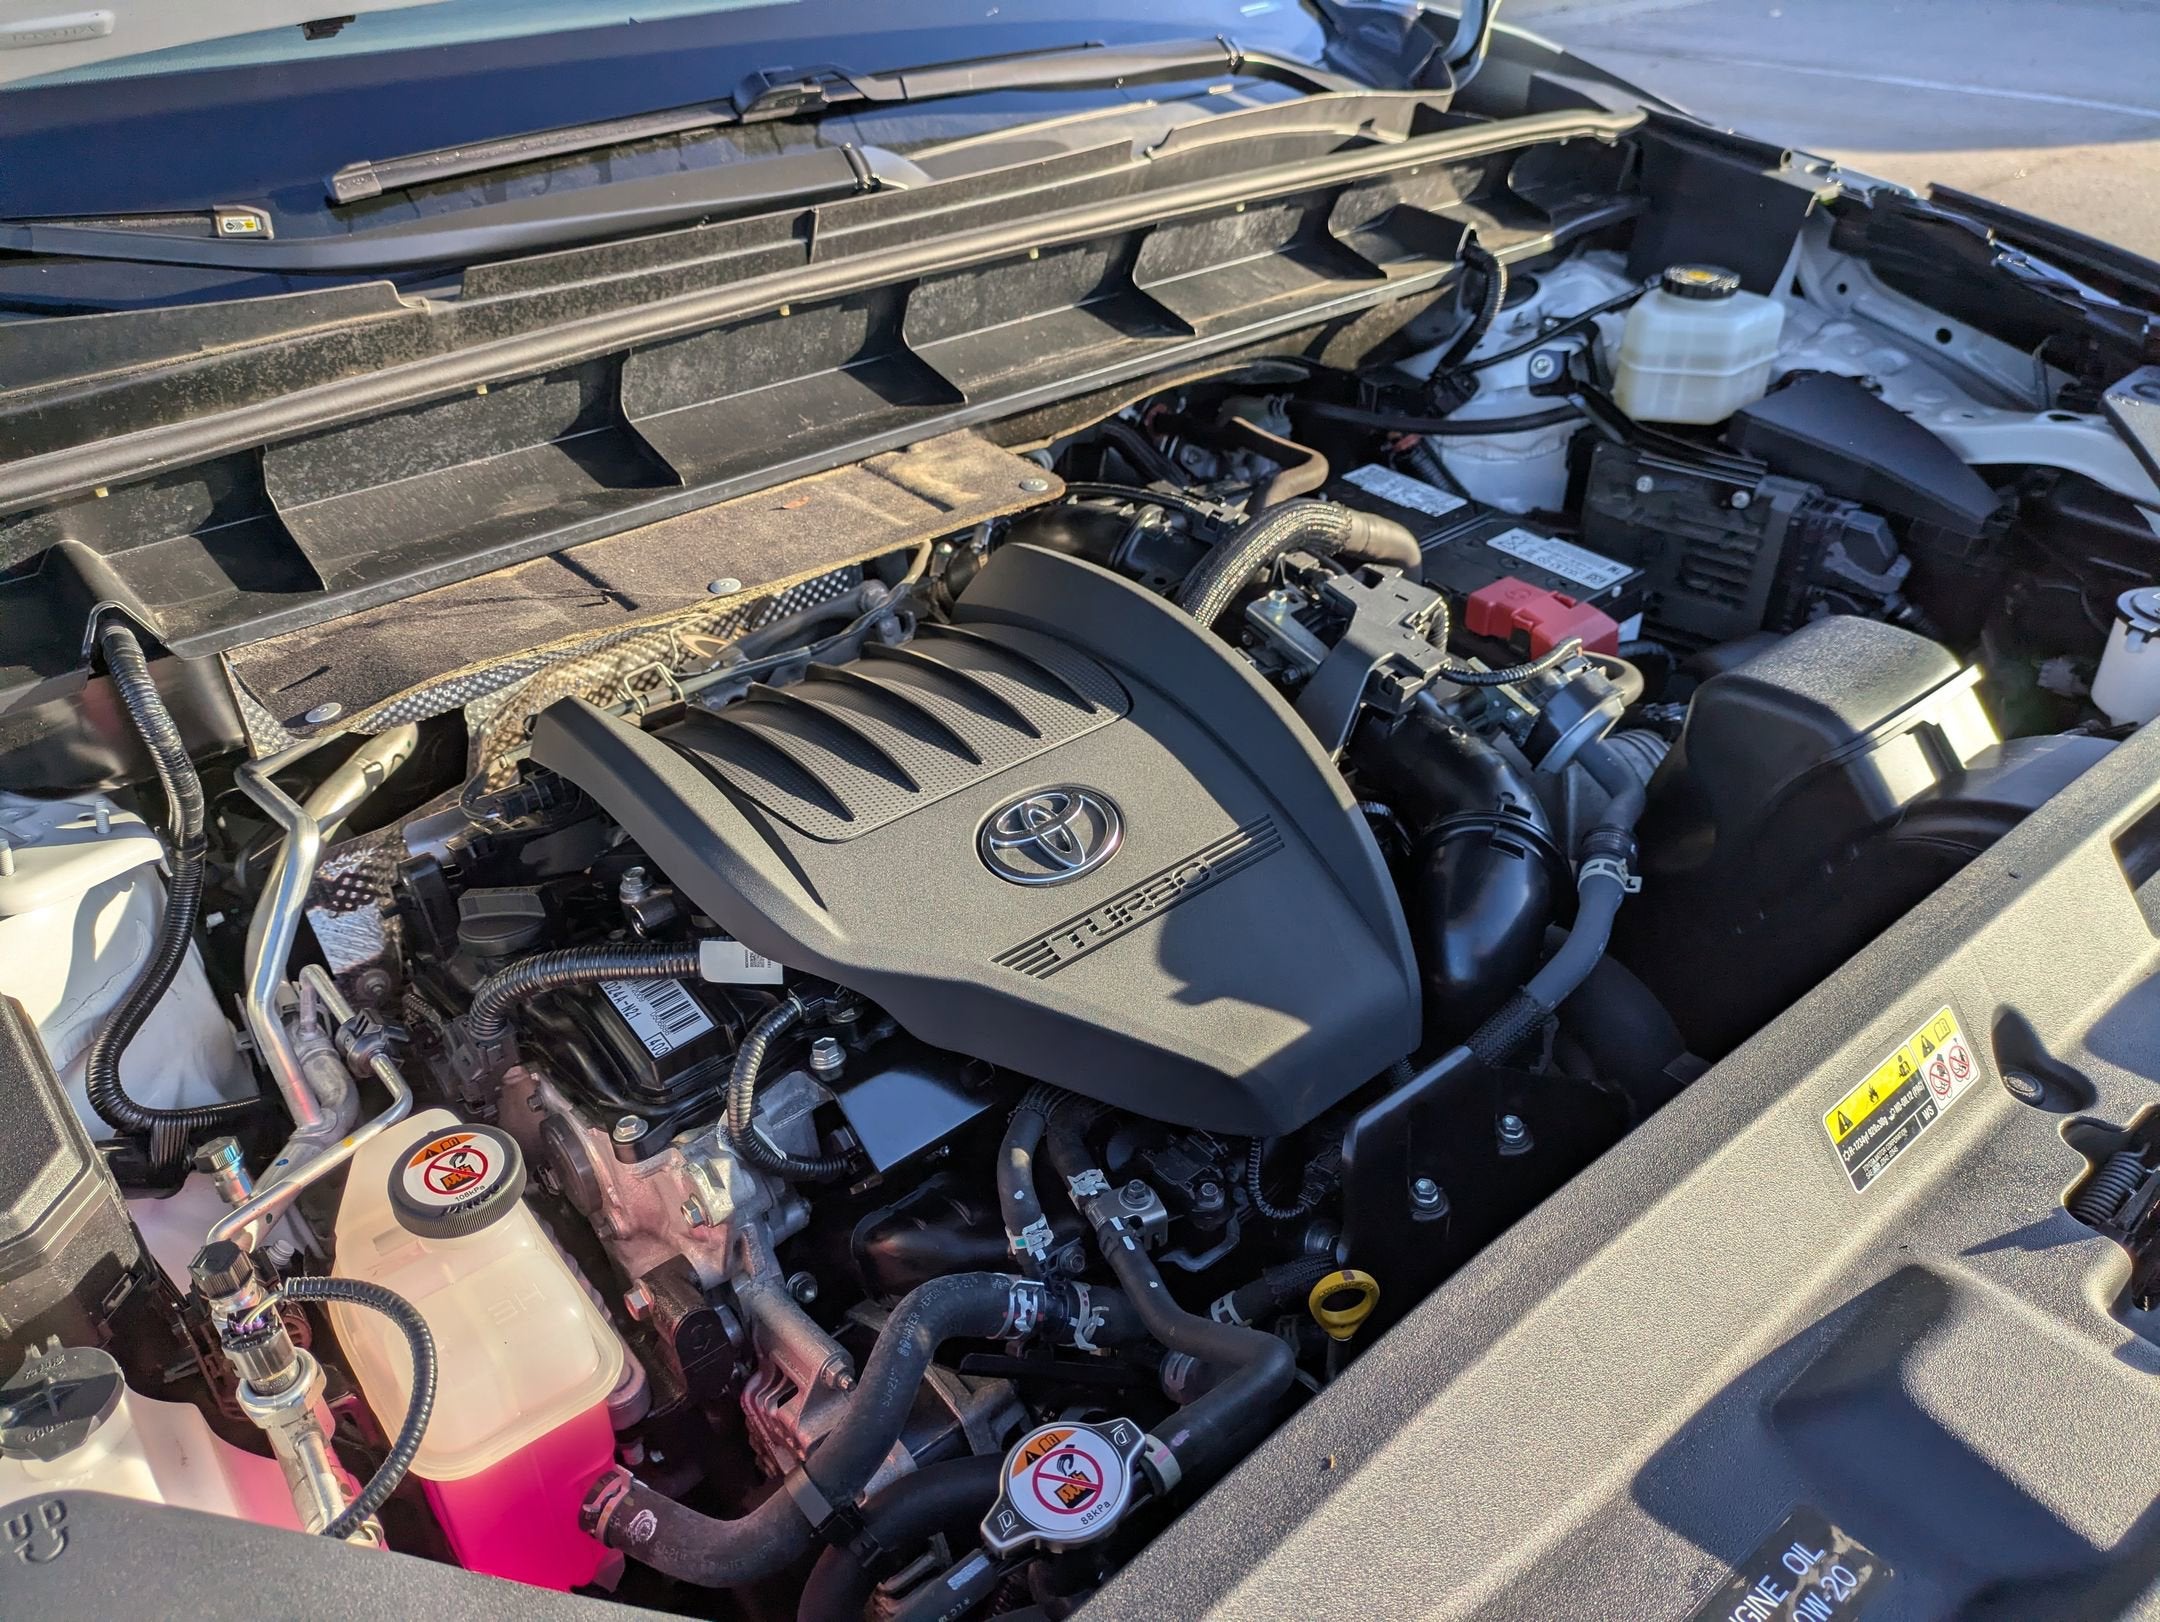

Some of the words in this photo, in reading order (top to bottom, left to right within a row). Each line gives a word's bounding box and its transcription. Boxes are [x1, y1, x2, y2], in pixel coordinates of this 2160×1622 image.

[1049, 861, 1210, 949] TURBO
[649, 1038, 670, 1056] 400
[455, 1185, 486, 1202] 108kPa
[1081, 1500, 1111, 1525] 88kPa
[1728, 1575, 1790, 1622] GINE
[1782, 1542, 1825, 1576] OIL
[1792, 1565, 1858, 1622] 0W-20
